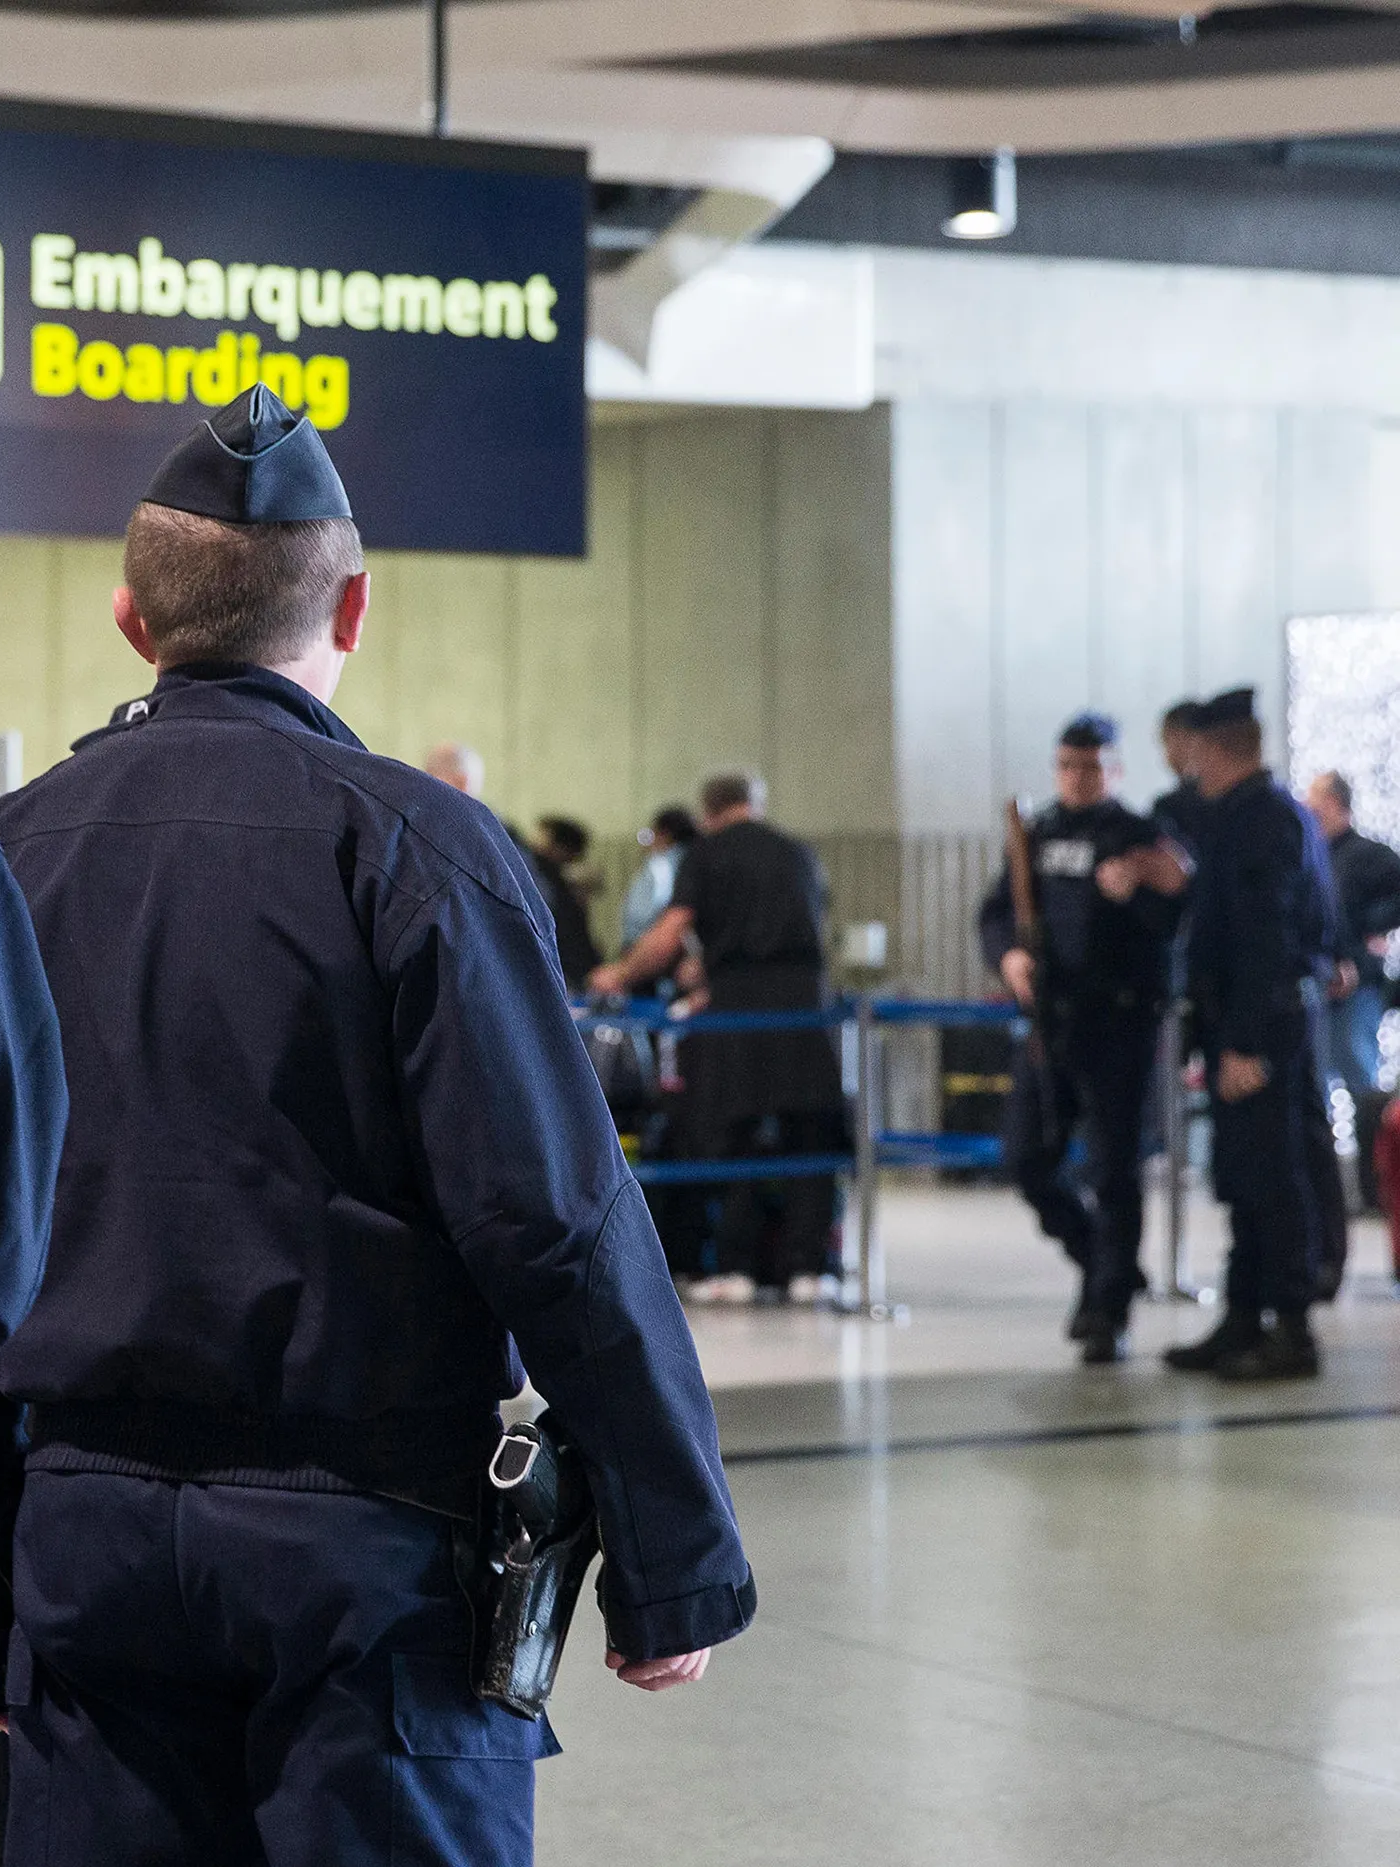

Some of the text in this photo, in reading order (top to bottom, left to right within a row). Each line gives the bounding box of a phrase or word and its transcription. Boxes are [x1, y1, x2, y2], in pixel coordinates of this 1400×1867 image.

[31, 234, 558, 342] Embarquement
[31, 322, 348, 430] Boarding
[125, 700, 149, 722] P
